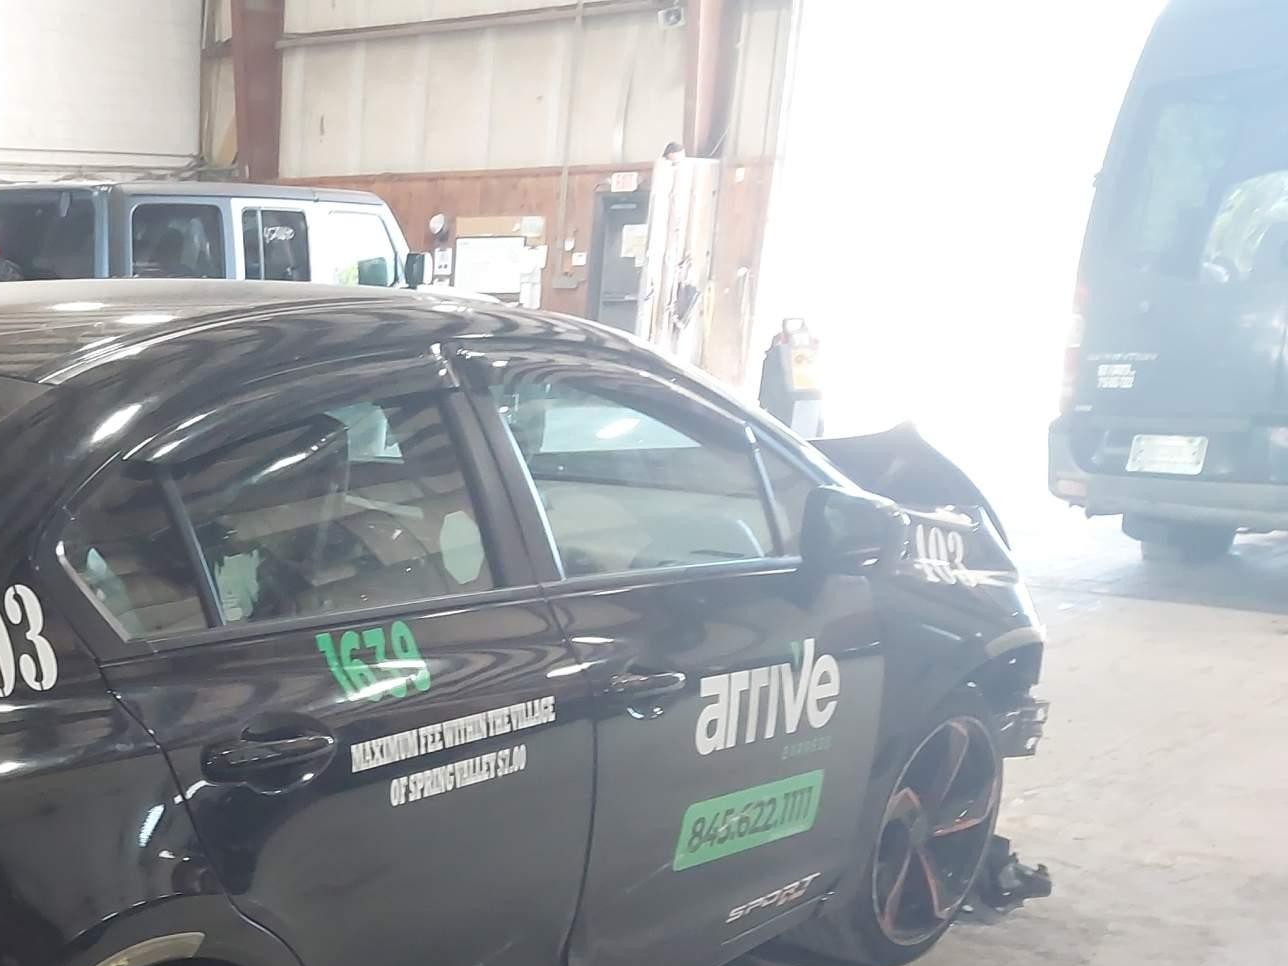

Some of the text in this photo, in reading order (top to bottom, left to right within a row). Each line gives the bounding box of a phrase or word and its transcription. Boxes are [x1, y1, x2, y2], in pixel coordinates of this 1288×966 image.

[695, 638, 840, 755] arrive
[351, 696, 556, 773] MAXIMUM FEE WITHIN THE VILLAGE
[390, 776, 408, 807] OF
[408, 763, 455, 802] SPRING
[454, 752, 497, 789] VALLEY
[686, 785, 814, 854] 845.622.1111
[725, 872, 821, 924] SPORT
